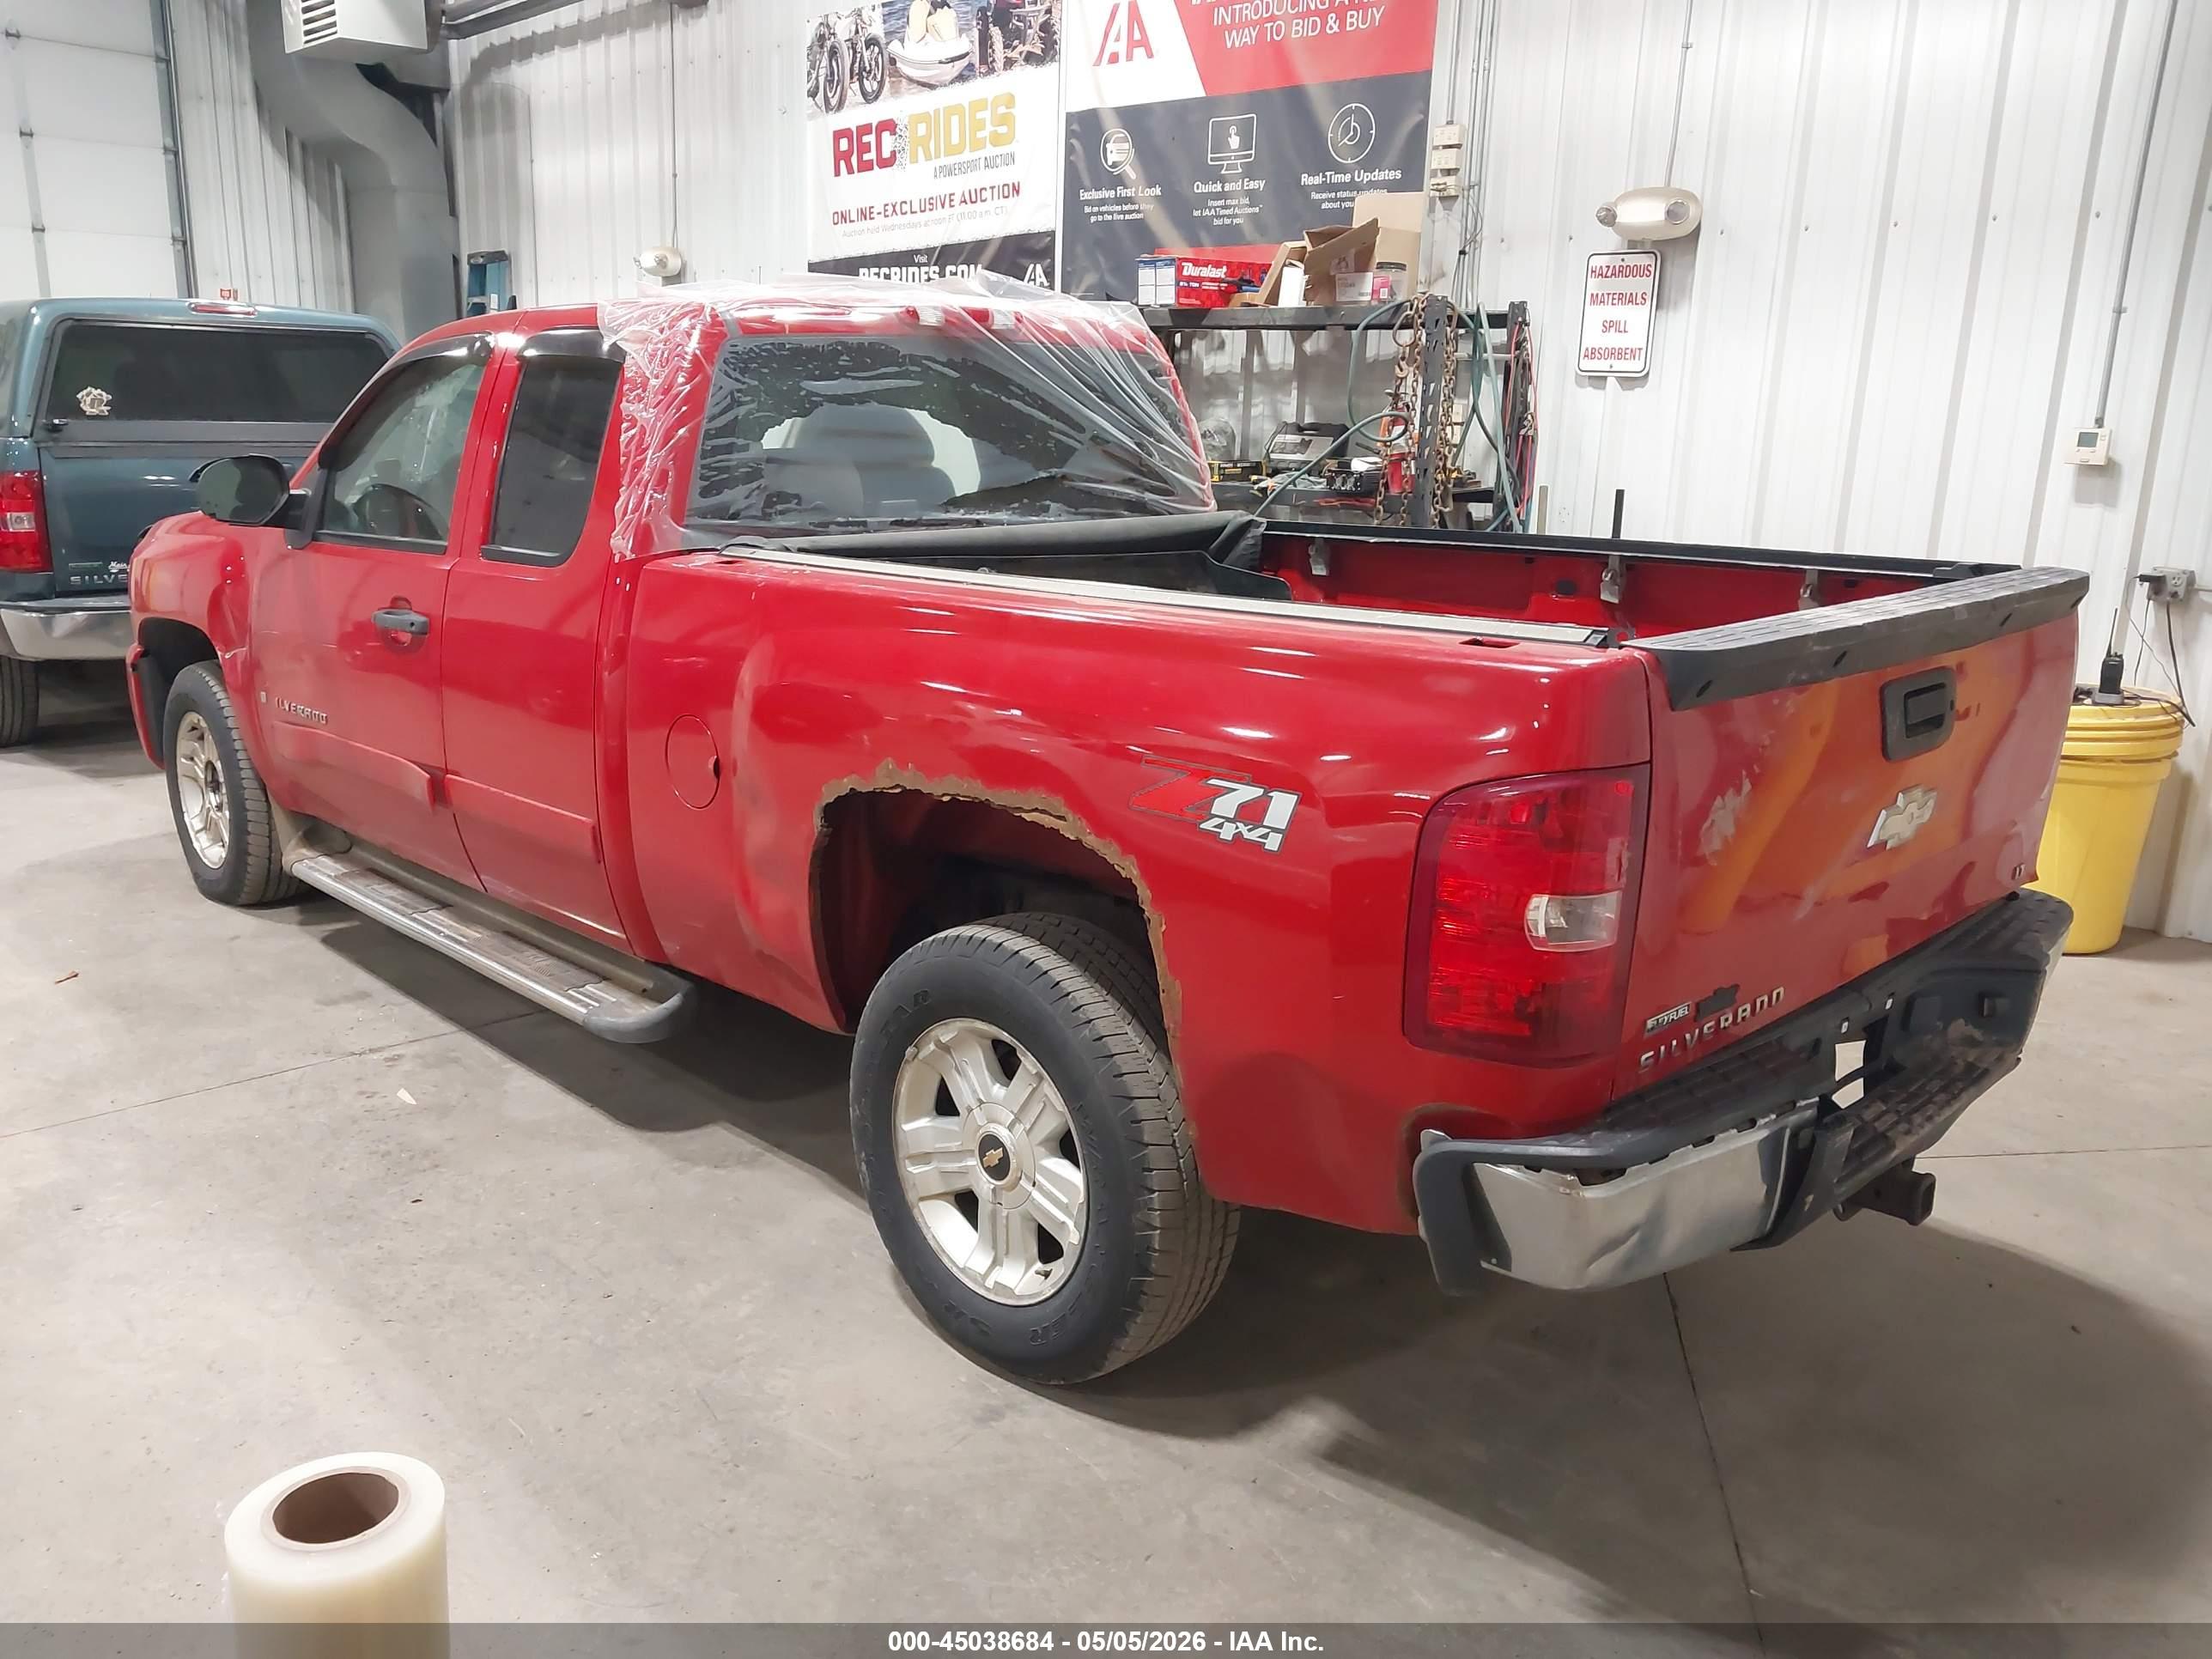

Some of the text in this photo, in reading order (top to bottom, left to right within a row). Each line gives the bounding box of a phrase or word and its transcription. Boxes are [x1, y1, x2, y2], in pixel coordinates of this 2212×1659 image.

[1224, 5, 1385, 49] WAY TO BID & BUY
[832, 92, 1017, 177] REC RIDES
[933, 151, 1016, 179] A POWERSPORT AUCTION
[1301, 168, 1402, 185] Real-Time Updates
[1079, 184, 1162, 200] Exclusive First Look
[1194, 178, 1266, 192] Quick and Easy
[1310, 191, 1336, 199] Receive
[832, 181, 1021, 226] ONLINE-EXCLUSIVE AUCTION
[1321, 200, 1340, 210] about
[1213, 216, 1223, 225] bid
[913, 254, 928, 264] Visit
[1181, 262, 1227, 278] Duralast
[1590, 264, 1652, 279] HAZARDOUS
[1589, 291, 1647, 307] MATERIALS
[1601, 319, 1628, 333] SPILL
[1583, 346, 1643, 361] ABSORBENT
[70, 574, 128, 585] SILVE
[1129, 754, 1299, 830] Z71
[1639, 987, 1785, 1072] SILVERADO
